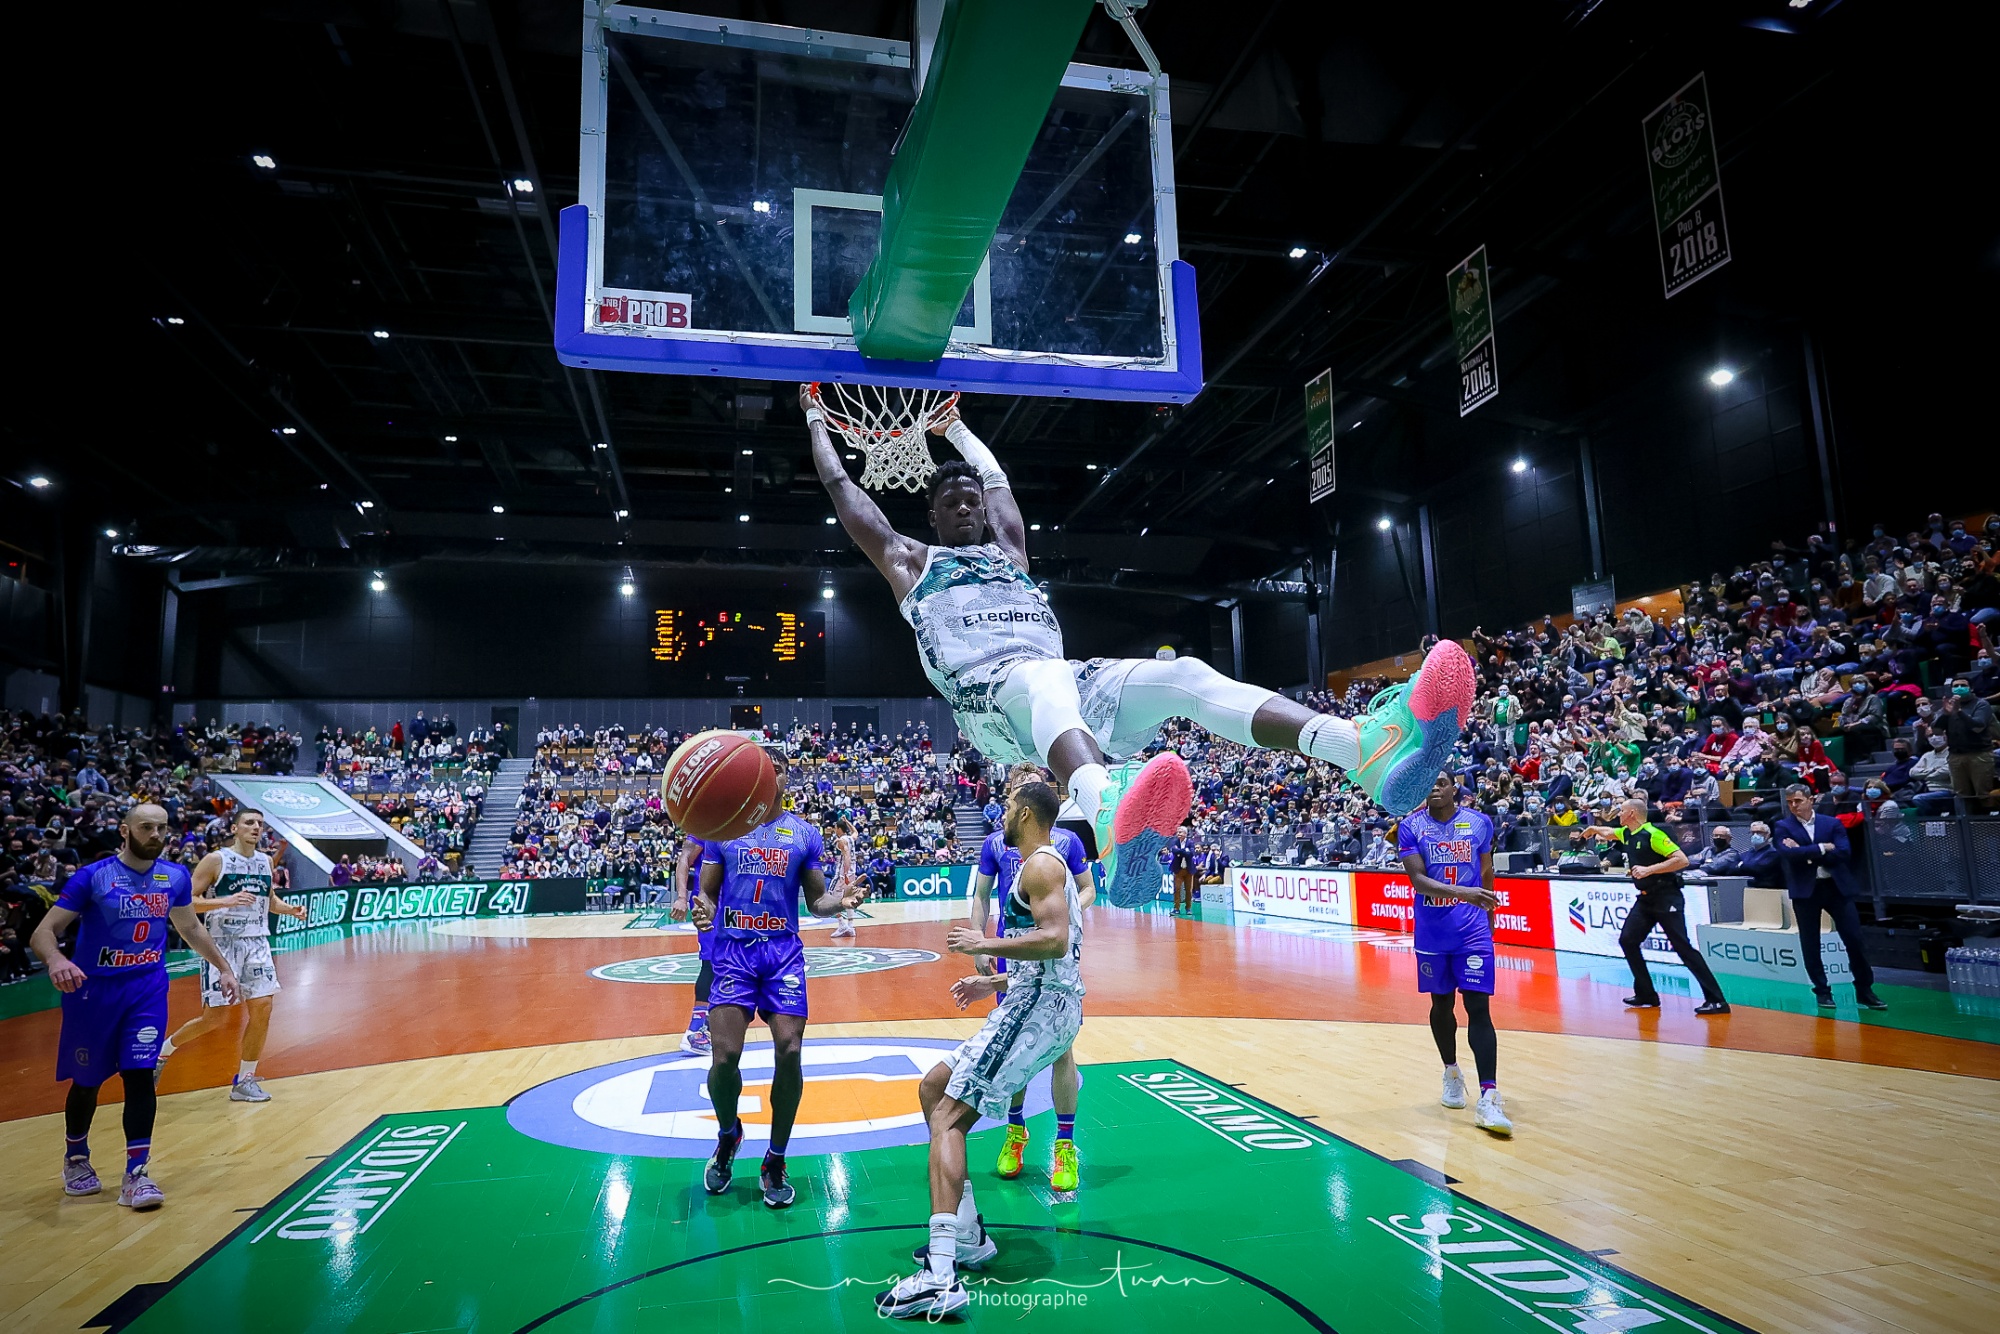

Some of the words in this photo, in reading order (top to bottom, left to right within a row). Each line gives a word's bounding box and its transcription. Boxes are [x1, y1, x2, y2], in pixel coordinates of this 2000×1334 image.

[1651, 112, 1706, 163] BLOIS
[1669, 221, 1719, 277] 2018
[1462, 361, 1491, 402] 2016
[1311, 462, 1332, 492] 2005
[963, 609, 1041, 627] E.Leclerc
[738, 847, 789, 864] ROUEN
[1429, 839, 1470, 856] ROUEN
[1430, 850, 1472, 864] METROPOLE
[737, 861, 788, 877] METROPOLE
[1444, 865, 1457, 884] 4
[753, 879, 764, 904] 1
[903, 873, 952, 896] adh
[1250, 874, 1274, 896] VAL
[1276, 876, 1296, 898] DU
[1299, 877, 1339, 904] CHER
[1384, 881, 1409, 899] GÉNIE
[120, 893, 168, 911] ROUEN
[1587, 891, 1631, 903] GROUPE
[119, 905, 169, 918] METROPOLE
[276, 894, 307, 934] ADA
[307, 889, 349, 928] BLOIS
[351, 883, 489, 922] BASKET
[488, 882, 530, 914] 41
[1371, 903, 1406, 919] STATION
[132, 921, 150, 943] 0
[1048, 992, 1066, 1013] 30
[1129, 1072, 1314, 1150] SIDAMO
[276, 1124, 451, 1240] SIDAMO
[1387, 1212, 1667, 1334] SIDA
